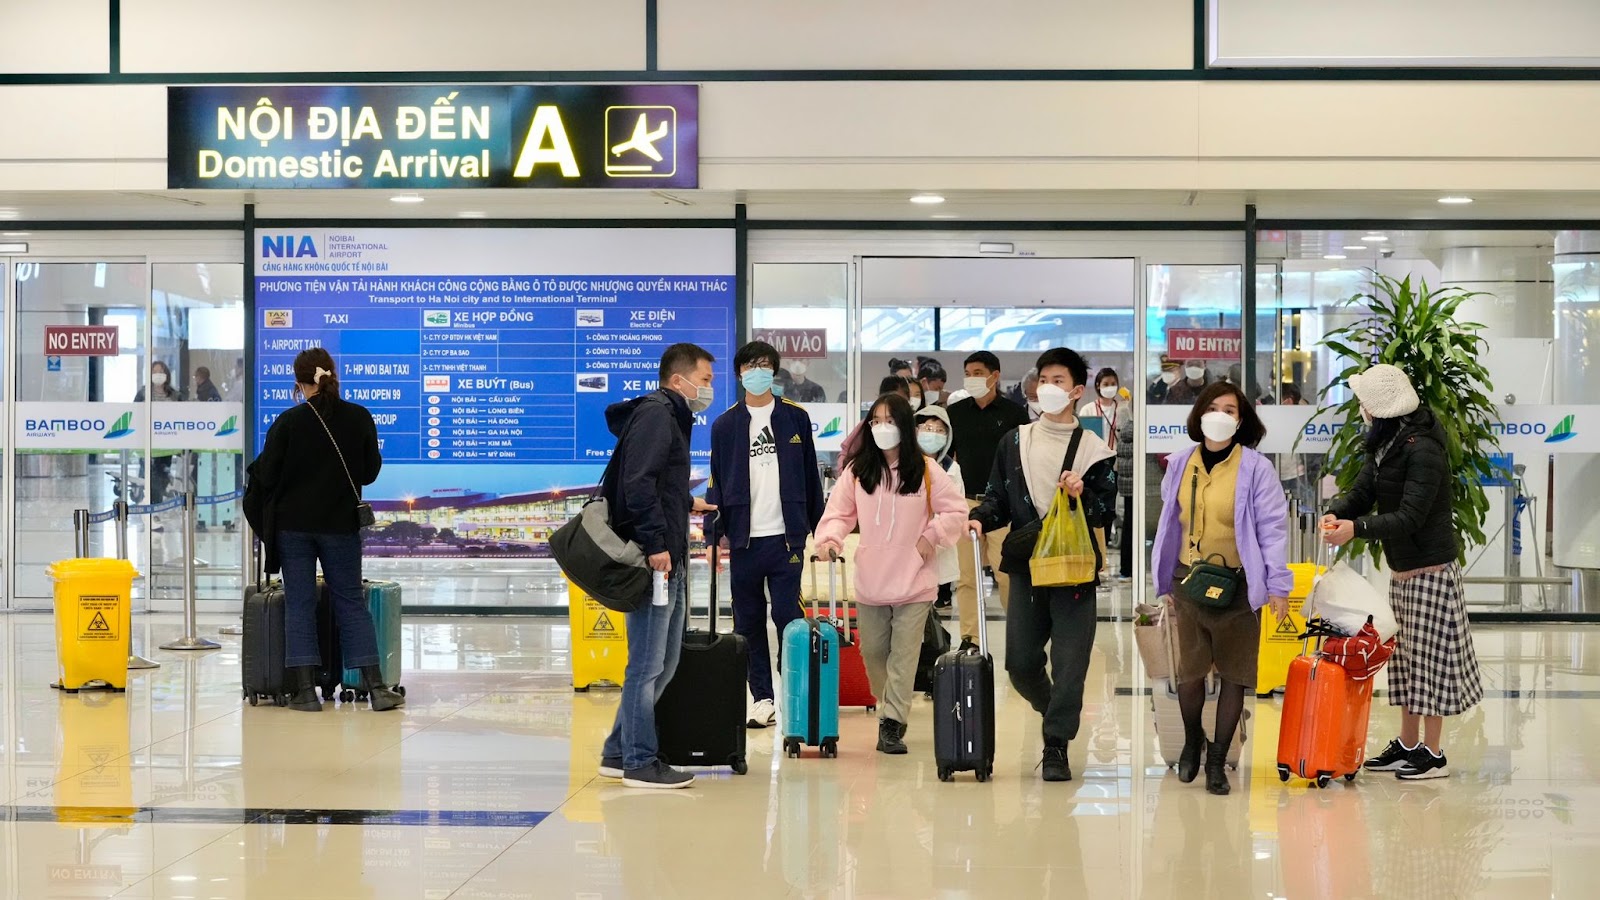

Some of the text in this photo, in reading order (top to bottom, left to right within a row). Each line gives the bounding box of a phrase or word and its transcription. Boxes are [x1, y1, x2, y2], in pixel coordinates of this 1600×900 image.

[217, 91, 490, 147] NỘI ĐỊA ĐẾN
[513, 105, 581, 178] A
[198, 149, 490, 178] Domestic Arrival
[262, 235, 318, 258] NIA
[260, 278, 728, 294] PHƯƠNG TIỆN VẬN TẢI HÀNH KHÁCH CÔNG CỘNG BẰNG Ô TÔ ĐƯỢC NHƯỢNG QUYỀN KHAI THÁC
[369, 295, 617, 305] Transport to Ha Noi city and to International Terminal
[324, 314, 349, 324] TAXI
[454, 308, 534, 324] XE HỢP ĐỒNG
[630, 309, 676, 323] XE ĐIỆN
[49, 333, 115, 349] NO ENTRY
[271, 340, 303, 350] AIRPORT
[304, 339, 321, 350] TAXI
[791, 331, 822, 352] VÀO
[1176, 337, 1241, 351] NO ENTRY
[271, 365, 285, 375] NOI
[353, 365, 363, 375] HP
[365, 365, 377, 375] NOI
[379, 365, 392, 375] BAI
[393, 365, 410, 375] TAXI
[458, 377, 534, 391] XE BUÝT (Bus)
[623, 380, 641, 391] XE
[271, 389, 288, 400] TAXI
[353, 389, 369, 400] TAXI
[371, 389, 391, 400] OPEN
[393, 389, 401, 400] 99
[26, 420, 105, 431] BAMBOO
[153, 421, 216, 431] BAMBOO
[586, 449, 604, 457] Free
